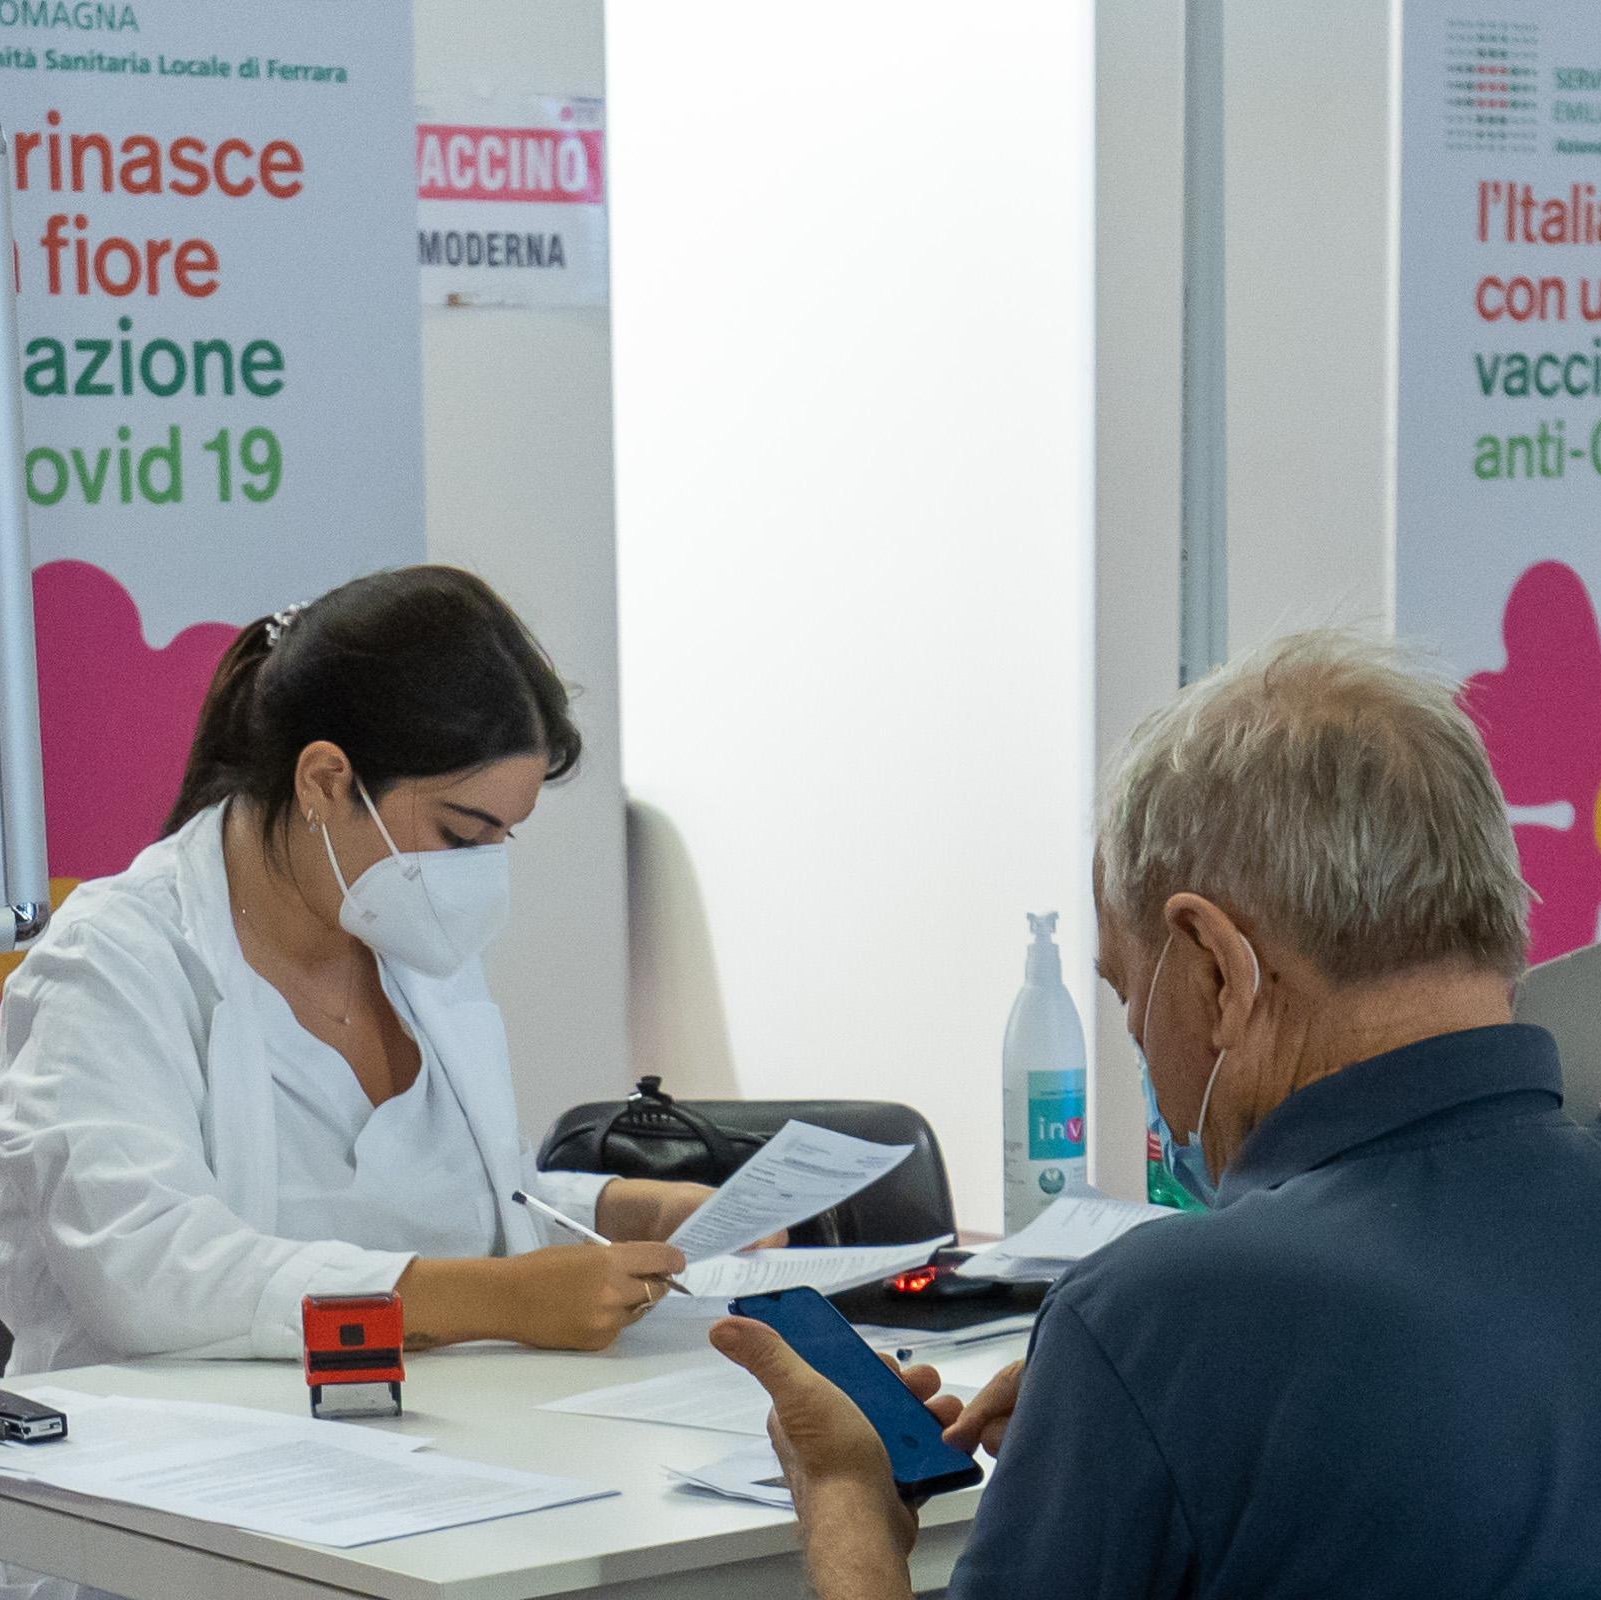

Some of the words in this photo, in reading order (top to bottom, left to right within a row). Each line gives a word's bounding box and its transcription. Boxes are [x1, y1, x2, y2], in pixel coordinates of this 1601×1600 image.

[45, 49, 150, 74] Sanitaria
[159, 55, 231, 78] Locale
[239, 57, 260, 79] di
[267, 59, 348, 83] Ferrara
[14, 110, 305, 199] rinasce
[420, 134, 588, 192] ACCINO
[40, 213, 221, 298] fiore
[419, 229, 567, 268] MODERNA
[1475, 275, 1566, 323] con
[24, 315, 285, 396] azione
[25, 424, 184, 506] ovid
[204, 426, 283, 503] 19
